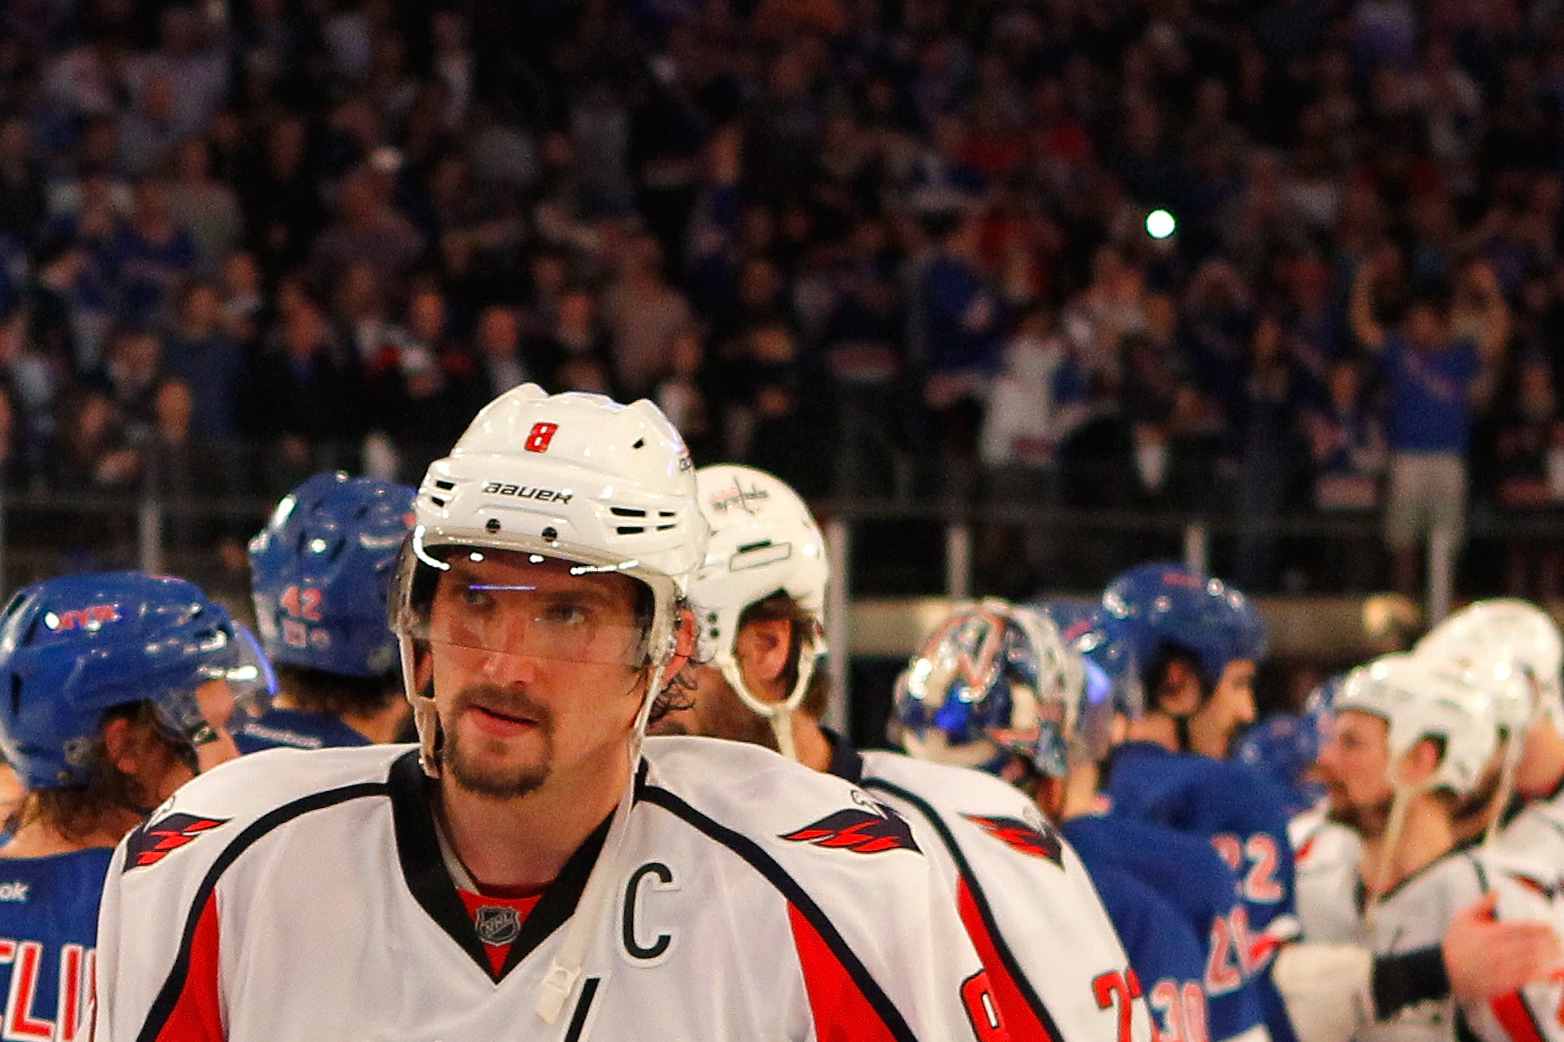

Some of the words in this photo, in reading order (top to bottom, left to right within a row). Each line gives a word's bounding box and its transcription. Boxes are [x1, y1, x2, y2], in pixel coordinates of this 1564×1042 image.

[524, 422, 558, 453] 8
[482, 481, 573, 505] BAUER
[281, 585, 324, 622] 42
[623, 862, 673, 960] C
